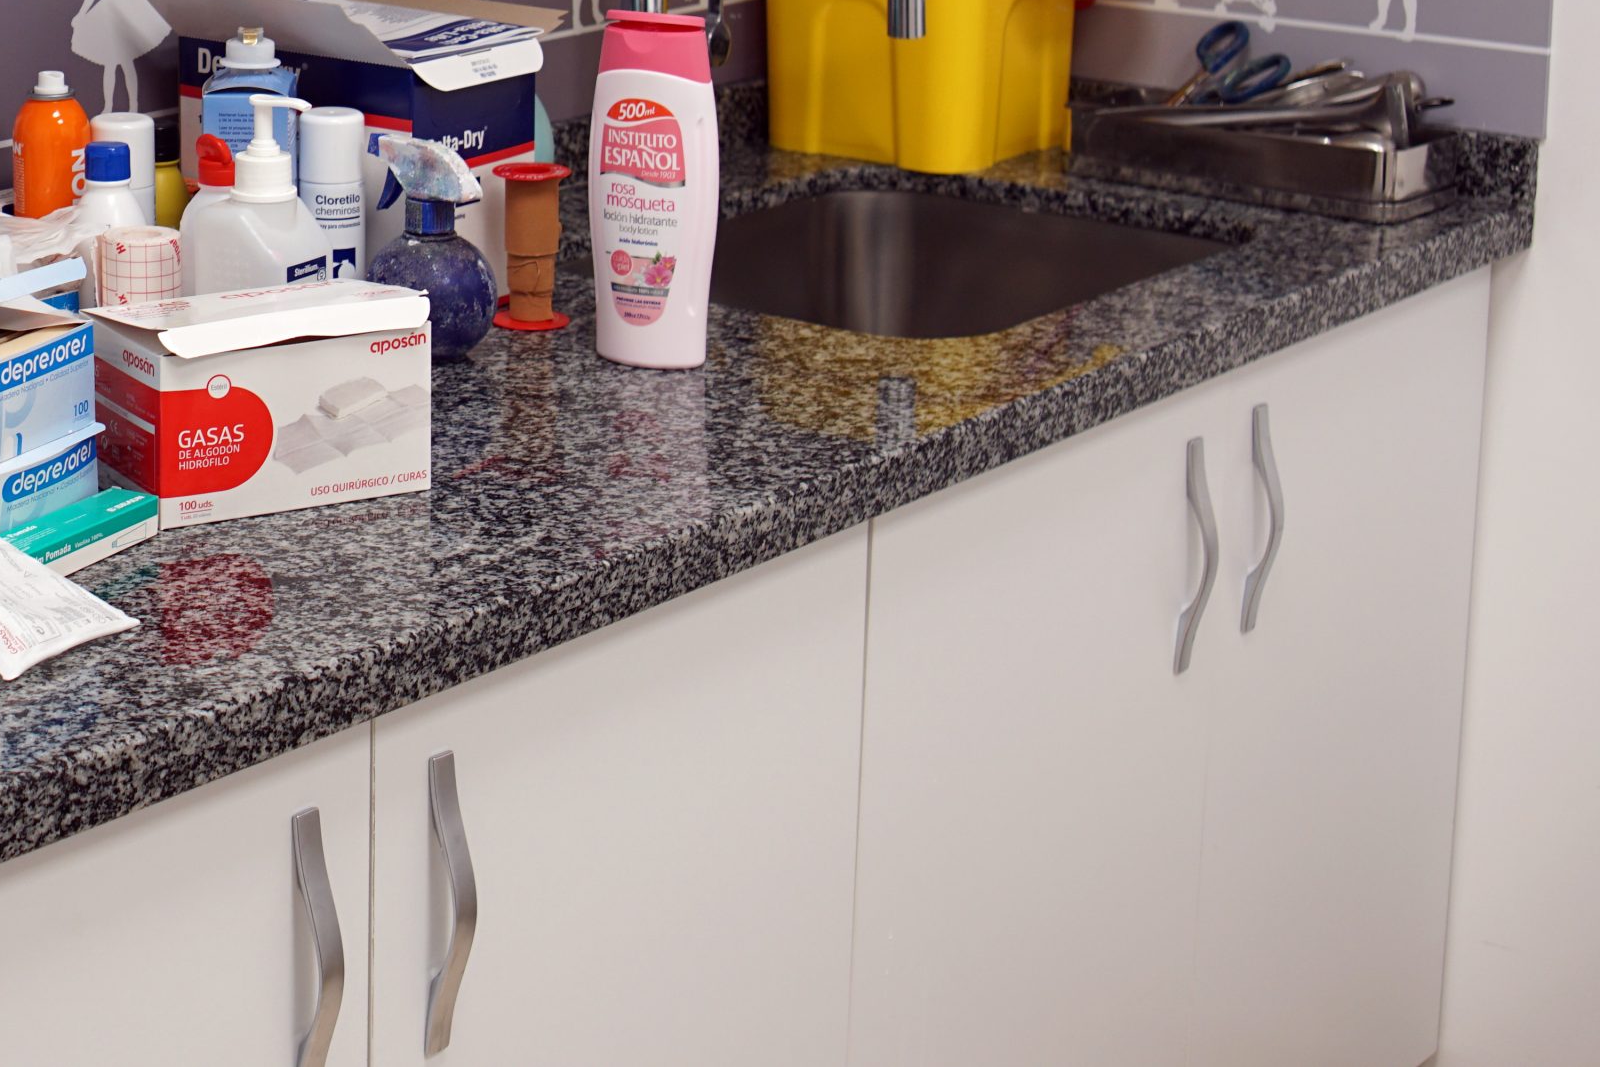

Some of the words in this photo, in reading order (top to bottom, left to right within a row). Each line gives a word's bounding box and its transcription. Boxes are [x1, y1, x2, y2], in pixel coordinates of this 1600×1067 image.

[617, 101, 656, 120] 500ml
[608, 129, 677, 149] INSTITUTO
[604, 145, 681, 171] ESPAÑOL
[659, 171, 676, 179] 1903
[611, 181, 636, 195] rosa
[315, 193, 360, 206] Cloretilo
[606, 194, 675, 212] mosqueta
[315, 205, 360, 217] chemirosa
[603, 209, 628, 223] loción
[629, 212, 678, 228] hidratante
[619, 224, 637, 234] body
[638, 226, 659, 235] lotion
[369, 332, 427, 355] aposán
[0, 334, 87, 384] depresores
[122, 349, 155, 377] aposán
[73, 400, 89, 417] 100
[178, 423, 245, 448] GASAS
[178, 449, 192, 460] DE
[193, 442, 241, 459] ALGODÓN
[11, 440, 92, 494] depresores
[178, 455, 230, 471] HIDRÓFILO
[310, 485, 330, 497] USO
[332, 476, 389, 493] QUIRÚRGICO
[390, 475, 396, 485] /
[397, 469, 427, 483] CURAS
[179, 500, 197, 512] 100
[198, 499, 214, 509] uds.
[45, 543, 72, 562] Pomada
